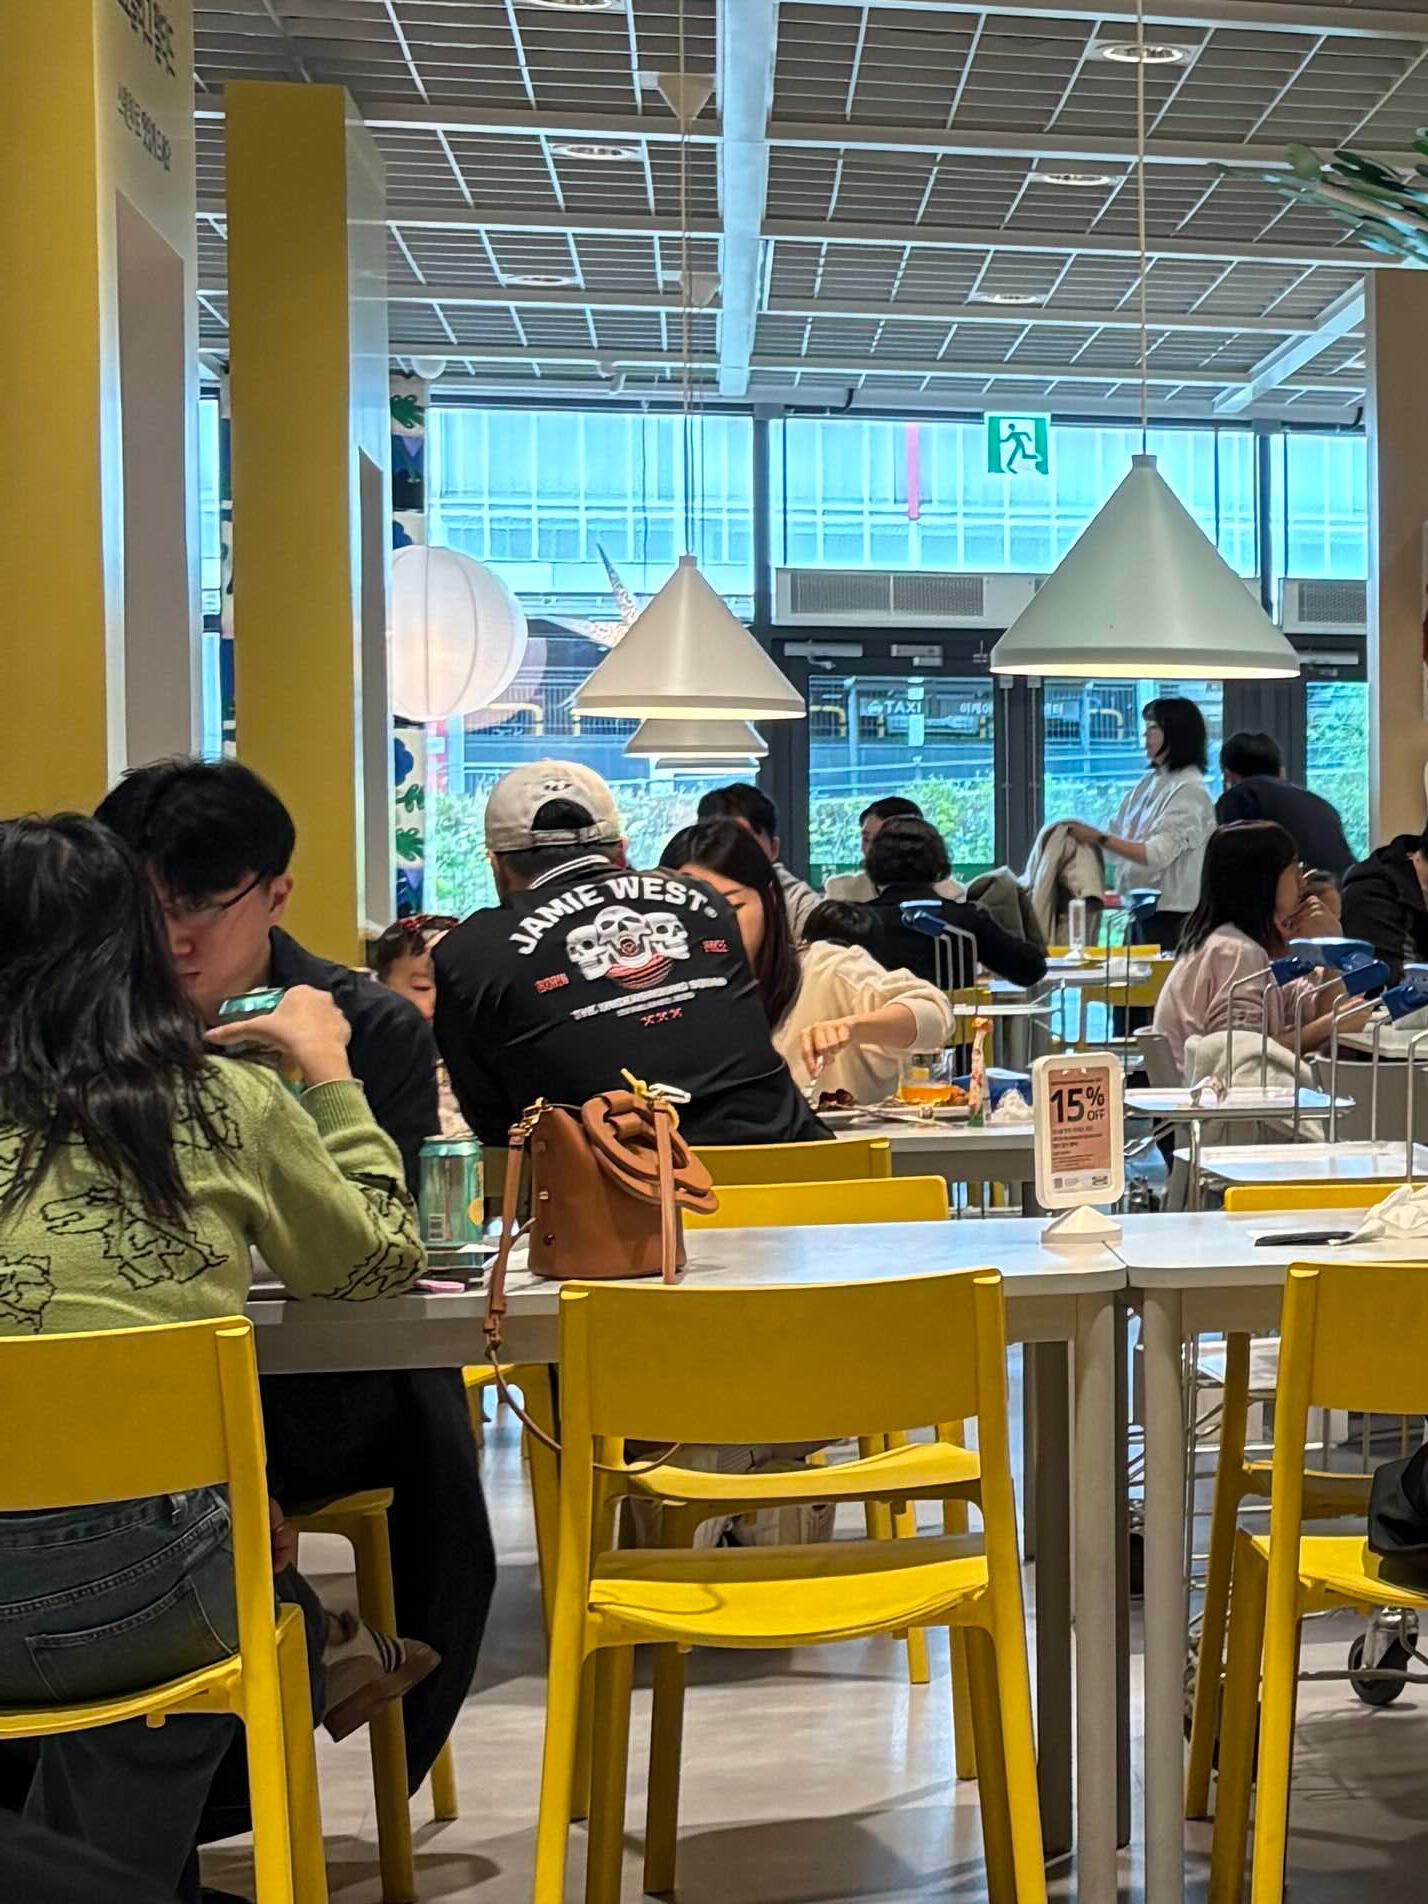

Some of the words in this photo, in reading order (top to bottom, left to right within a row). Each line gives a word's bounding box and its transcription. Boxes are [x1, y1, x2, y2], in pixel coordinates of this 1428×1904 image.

[883, 701, 922, 714] TAXI
[509, 884, 604, 954] JAMIE
[1087, 1110, 1105, 1122] OFF
